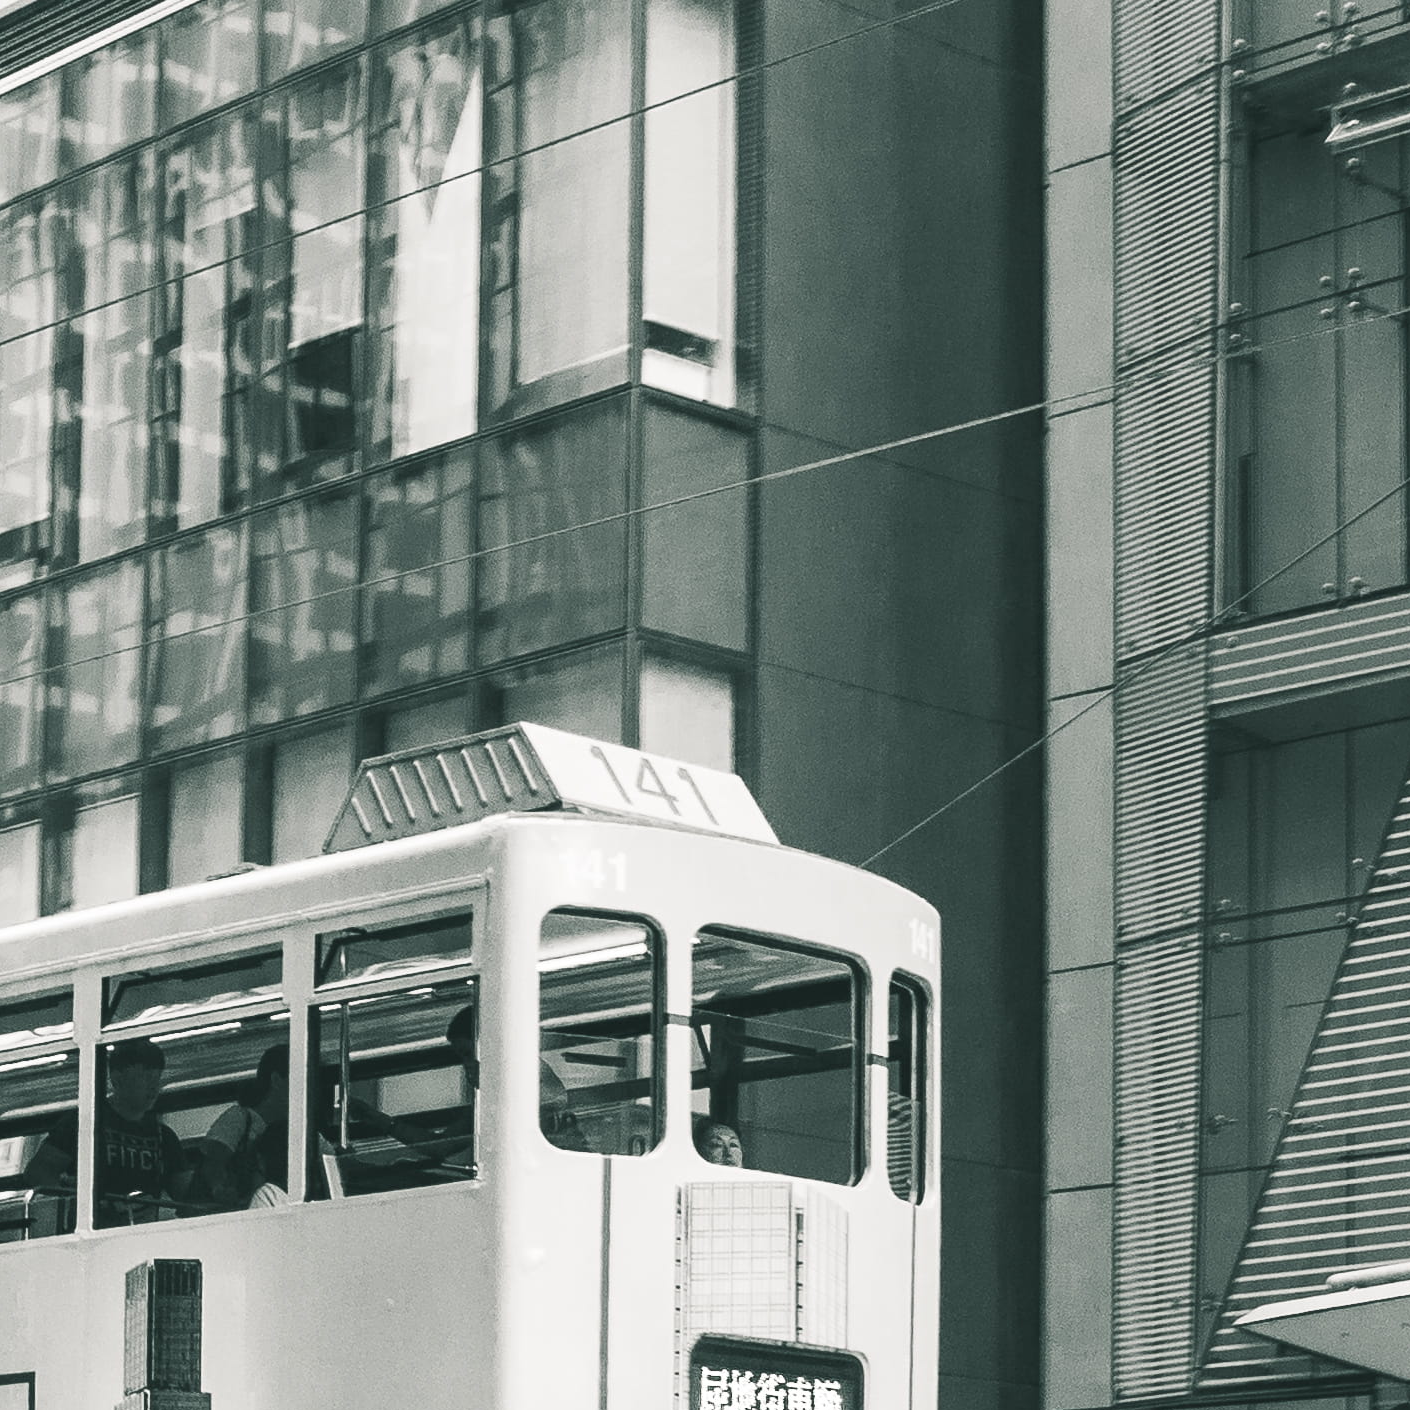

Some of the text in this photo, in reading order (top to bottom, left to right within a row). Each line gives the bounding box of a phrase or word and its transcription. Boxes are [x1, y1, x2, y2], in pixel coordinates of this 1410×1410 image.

[590, 744, 718, 826] 141
[558, 847, 627, 893] 141
[908, 917, 936, 965] 141
